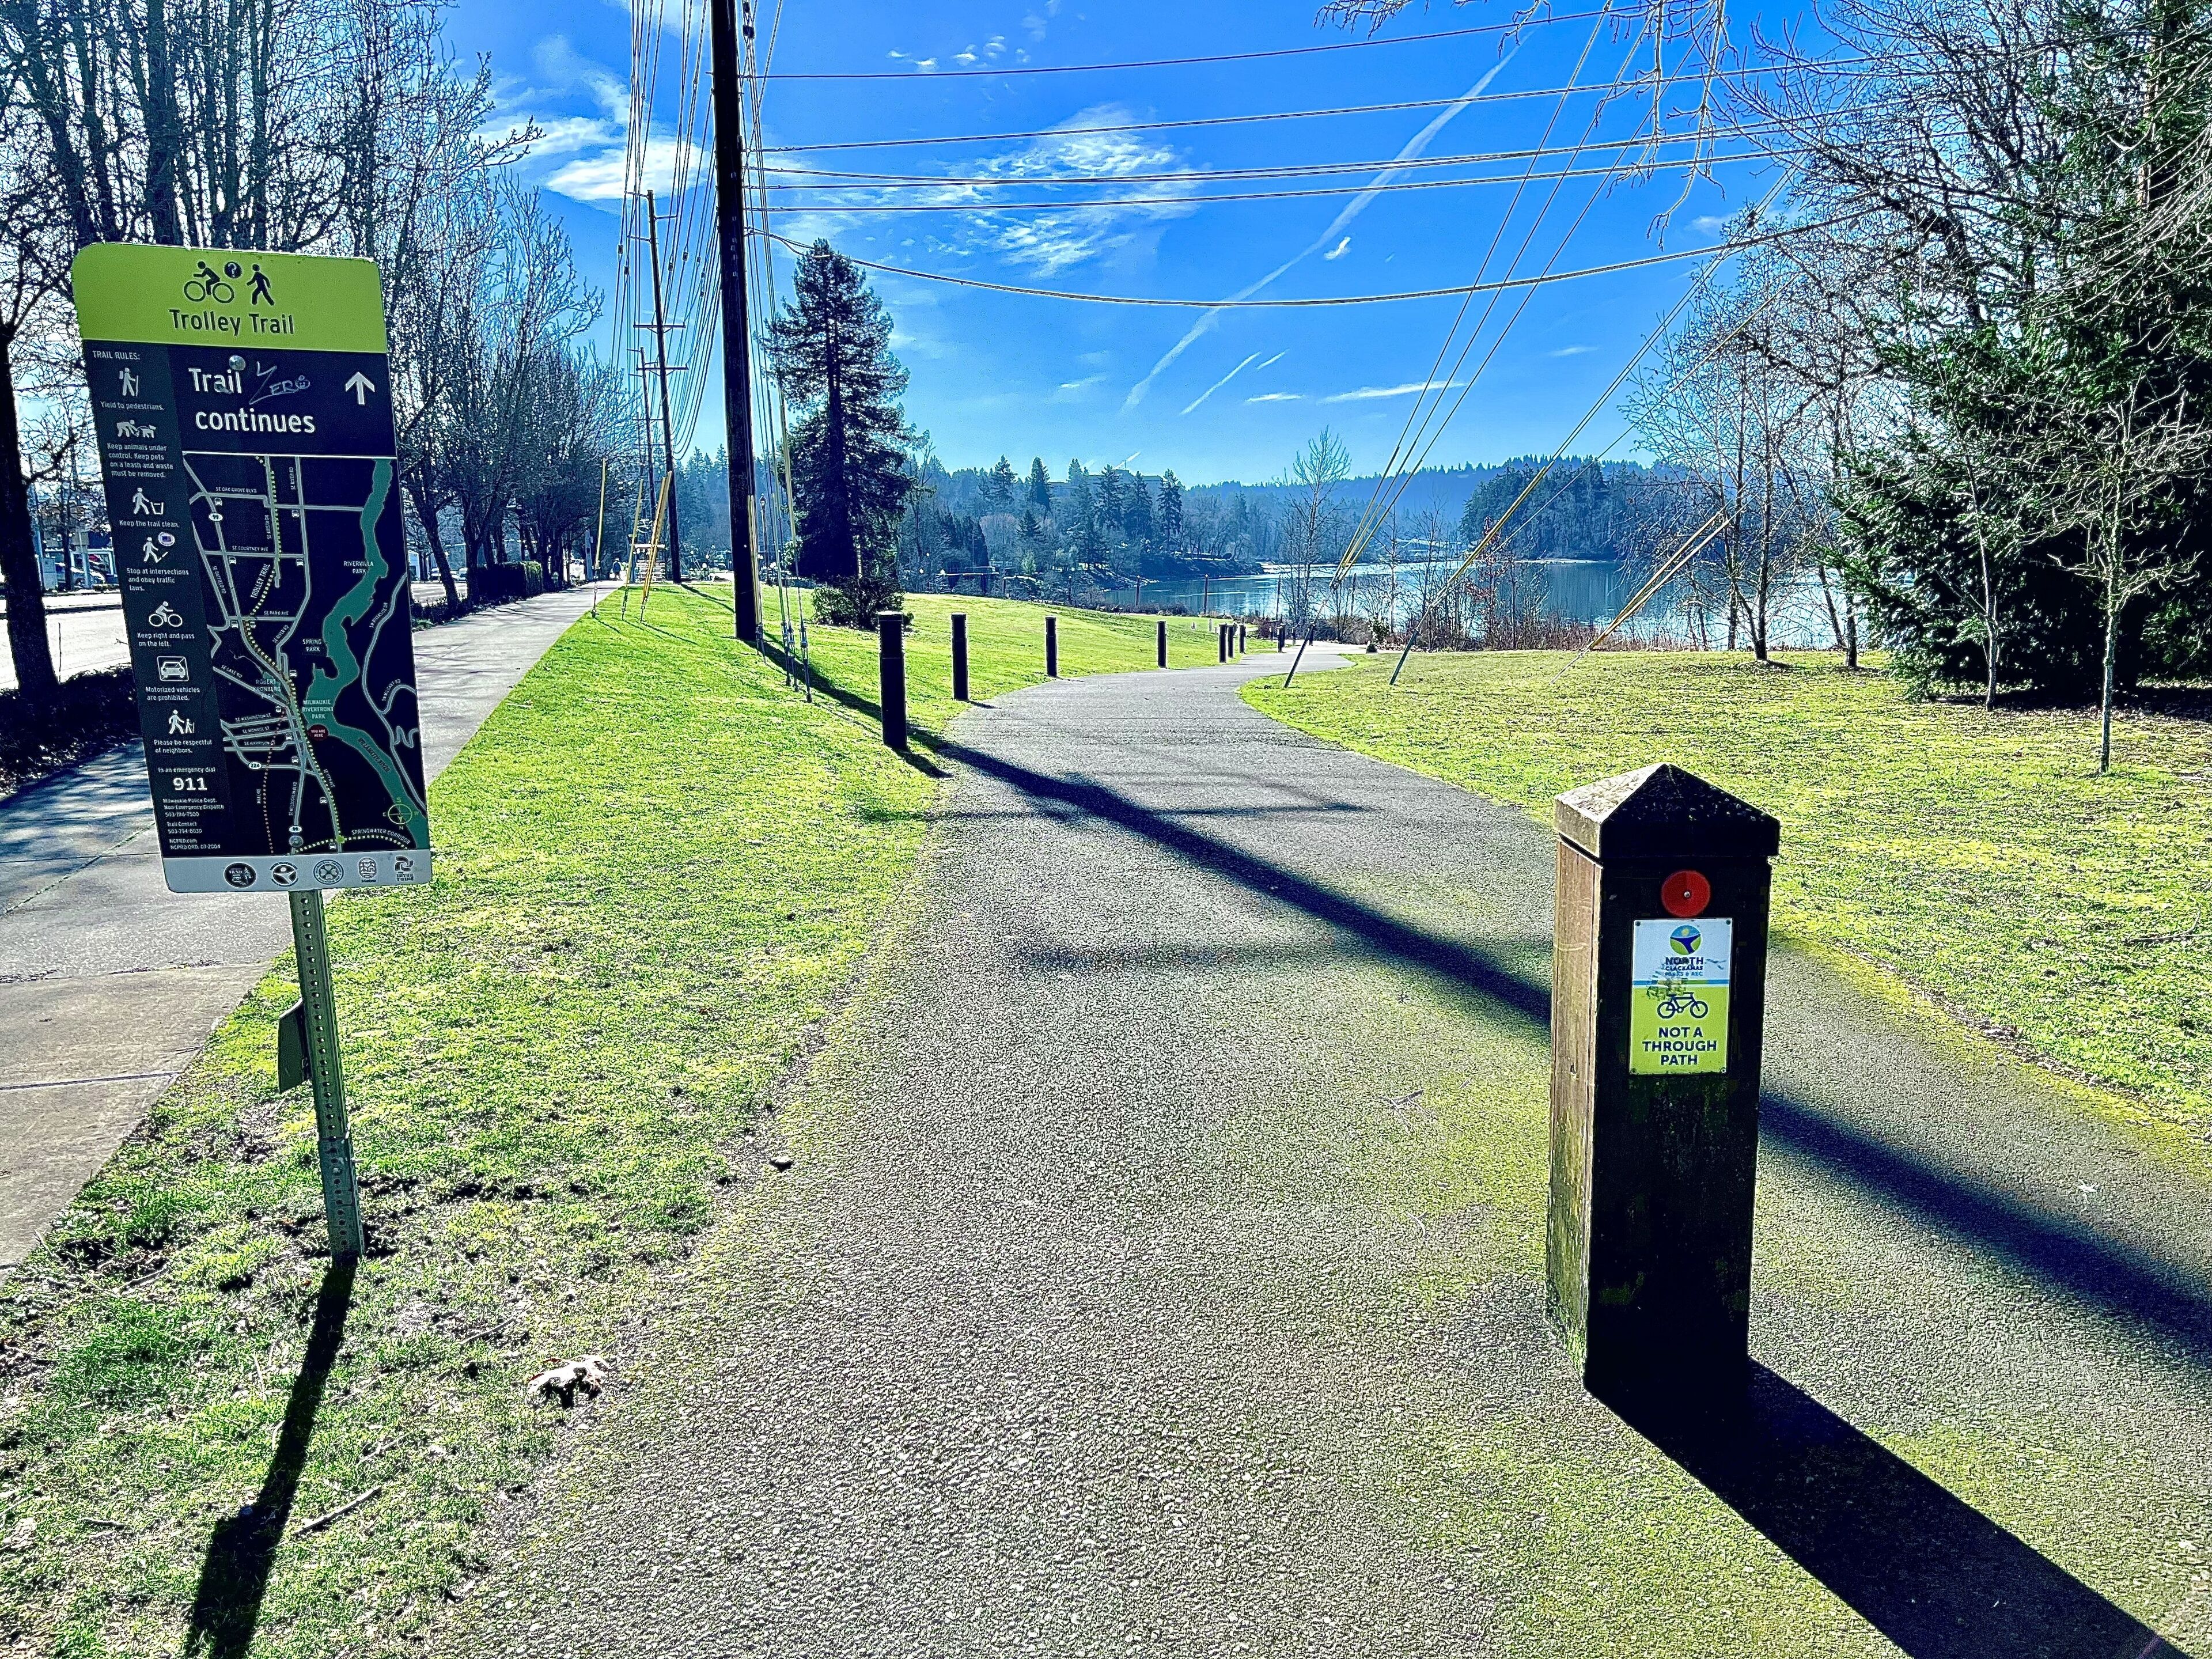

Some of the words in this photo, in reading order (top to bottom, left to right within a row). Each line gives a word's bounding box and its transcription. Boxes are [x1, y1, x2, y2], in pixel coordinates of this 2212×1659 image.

[169, 309, 241, 336] Trolley
[249, 313, 294, 334] Trail
[92, 350, 113, 359] TRAIL
[115, 351, 141, 360] RULES:
[188, 368, 242, 393] Trail
[195, 408, 316, 434] continues
[251, 578, 264, 599] TROLLEY
[259, 564, 270, 578] TRAIL
[173, 778, 207, 790] 911
[387, 830, 411, 844] CORRIDOR
[1665, 957, 1704, 965] NORTH
[1658, 1027, 1690, 1038] NOT
[1693, 1027, 1703, 1038] A
[1642, 1040, 1717, 1052] THROUGH
[1661, 1055, 1698, 1066] PATH
